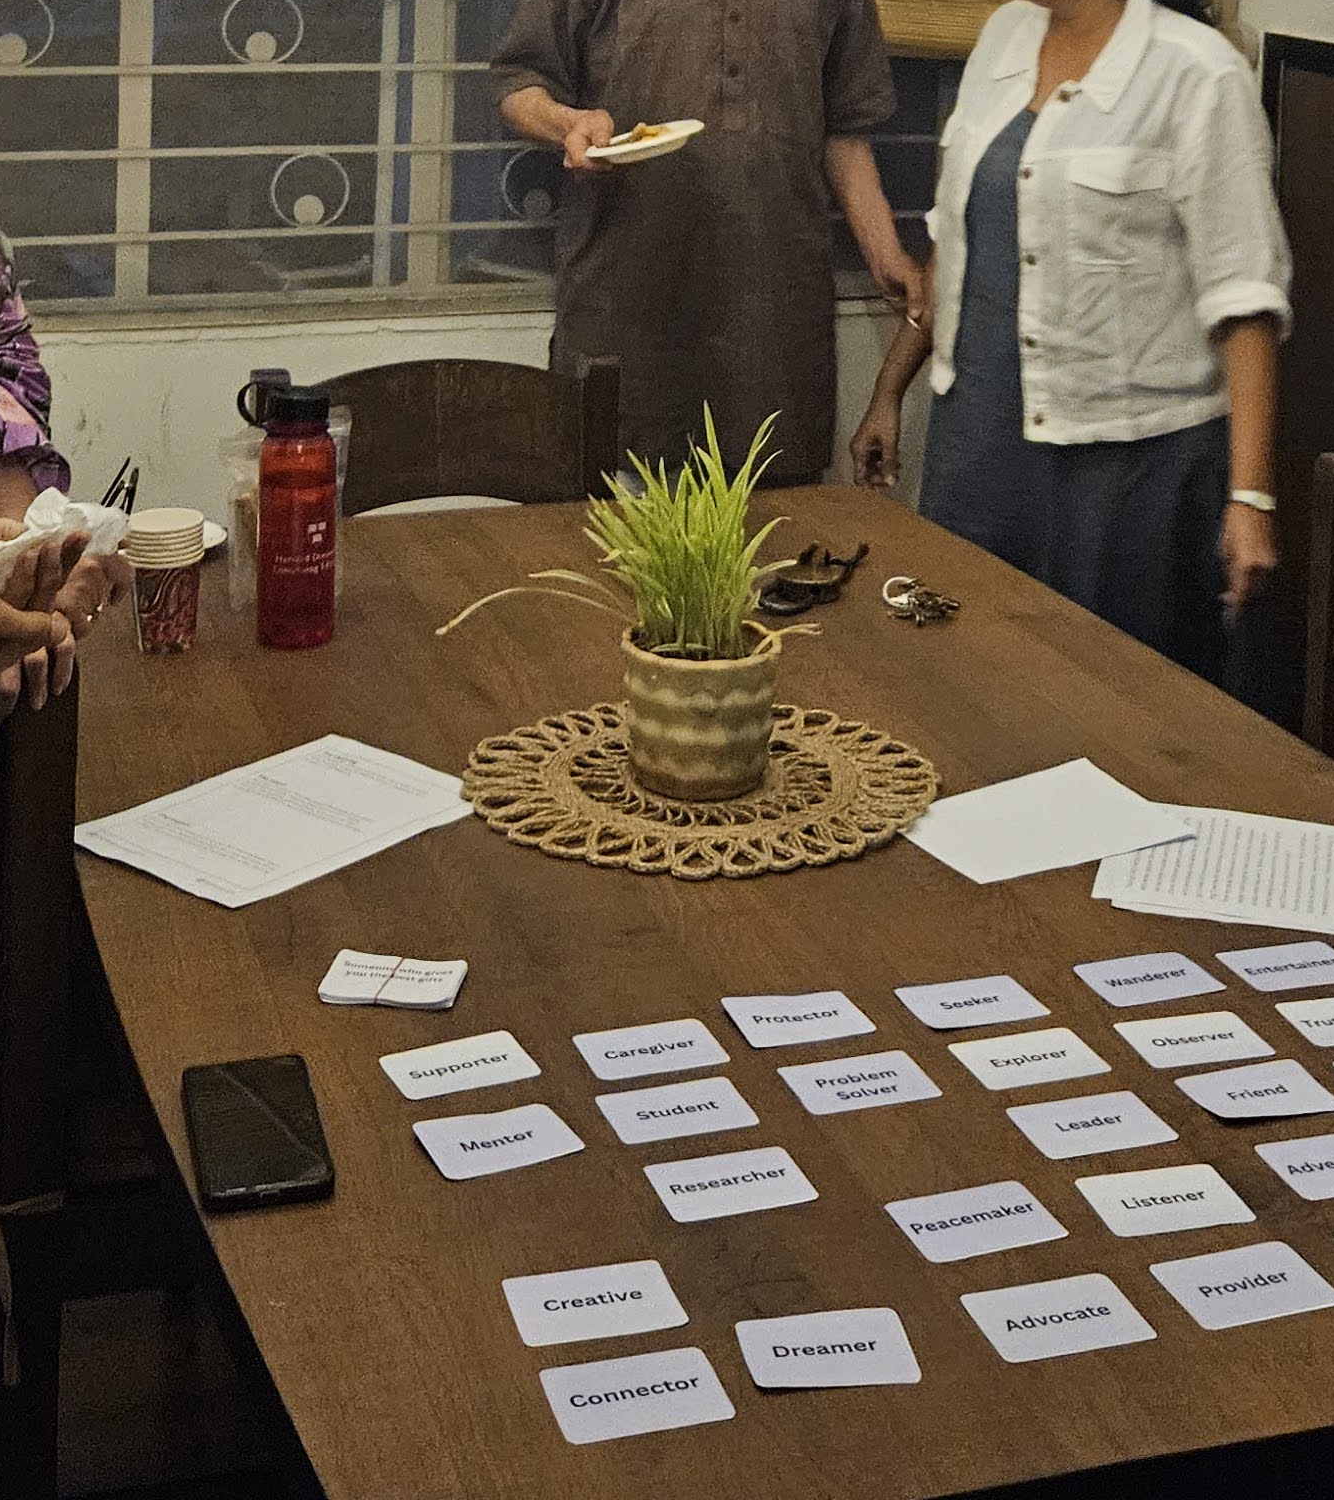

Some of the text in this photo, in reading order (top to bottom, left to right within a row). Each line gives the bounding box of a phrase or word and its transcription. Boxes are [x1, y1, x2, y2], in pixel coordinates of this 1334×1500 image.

[1104, 967, 1188, 988] Wanderer
[939, 994, 1001, 1010] Seeker
[751, 1008, 840, 1025] Protector
[1151, 1030, 1236, 1047] Observer
[604, 1039, 695, 1060] Caregiver
[989, 1048, 1068, 1068] Explorer
[409, 1051, 510, 1081] Supporter
[814, 1070, 898, 1089] Problem
[836, 1084, 898, 1100] Solver
[1226, 1082, 1290, 1101] Friend
[636, 1099, 720, 1121] Student
[1054, 1114, 1123, 1133] Leader
[459, 1129, 534, 1153] Mentor
[668, 1167, 787, 1196] Researcher
[1120, 1189, 1206, 1210] Listener
[909, 1199, 1035, 1236] Peacemaker
[1197, 1271, 1289, 1298] Provider
[543, 1289, 644, 1312] Creative
[1006, 1305, 1112, 1333] Advocate
[772, 1339, 878, 1358] Dreamer
[569, 1376, 700, 1408] Connector
